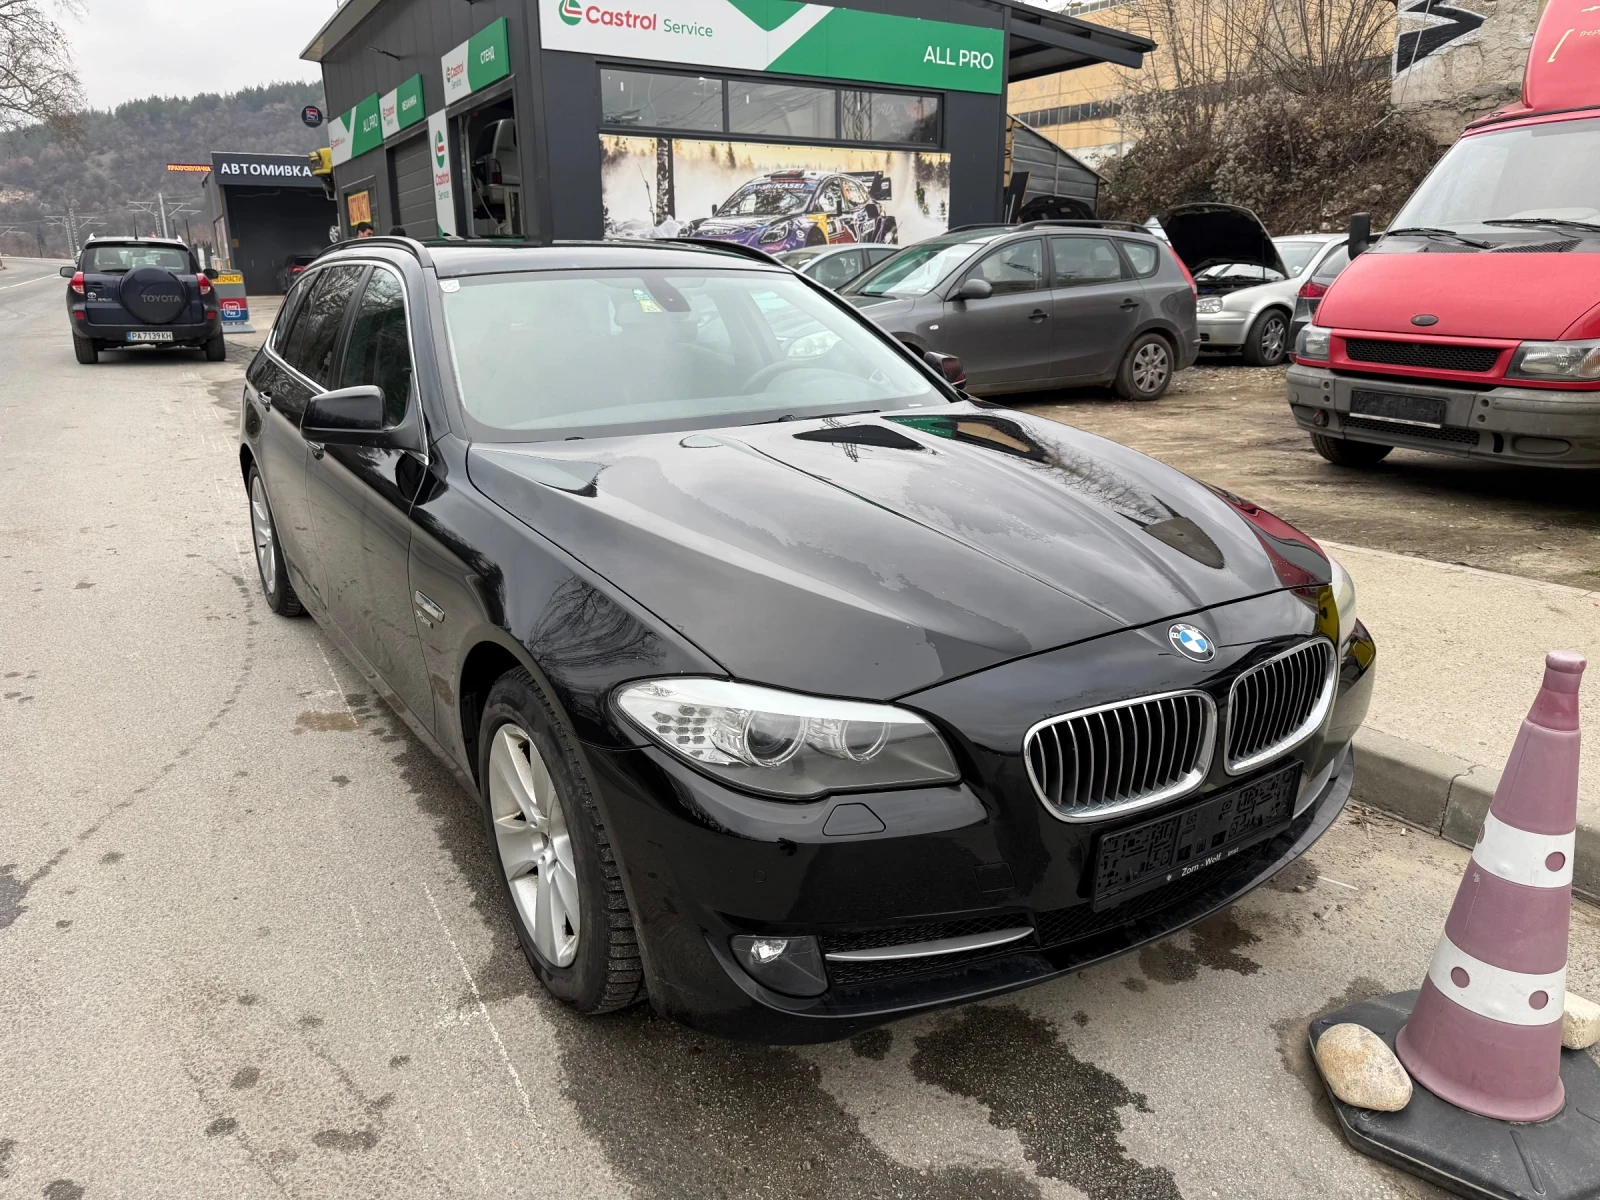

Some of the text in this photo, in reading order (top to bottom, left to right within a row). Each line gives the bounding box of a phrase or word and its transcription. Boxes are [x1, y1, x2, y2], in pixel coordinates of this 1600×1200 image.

[585, 5, 713, 37] Castrol Service
[923, 45, 994, 70] ALL PRO
[450, 60, 464, 79] Castrol
[220, 162, 313, 178] АВТОМИВКА
[435, 170, 450, 186] Castrol
[141, 294, 181, 303] TOYOTA
[225, 303, 238, 311] Easy
[1205, 852, 1222, 866] Wolf
